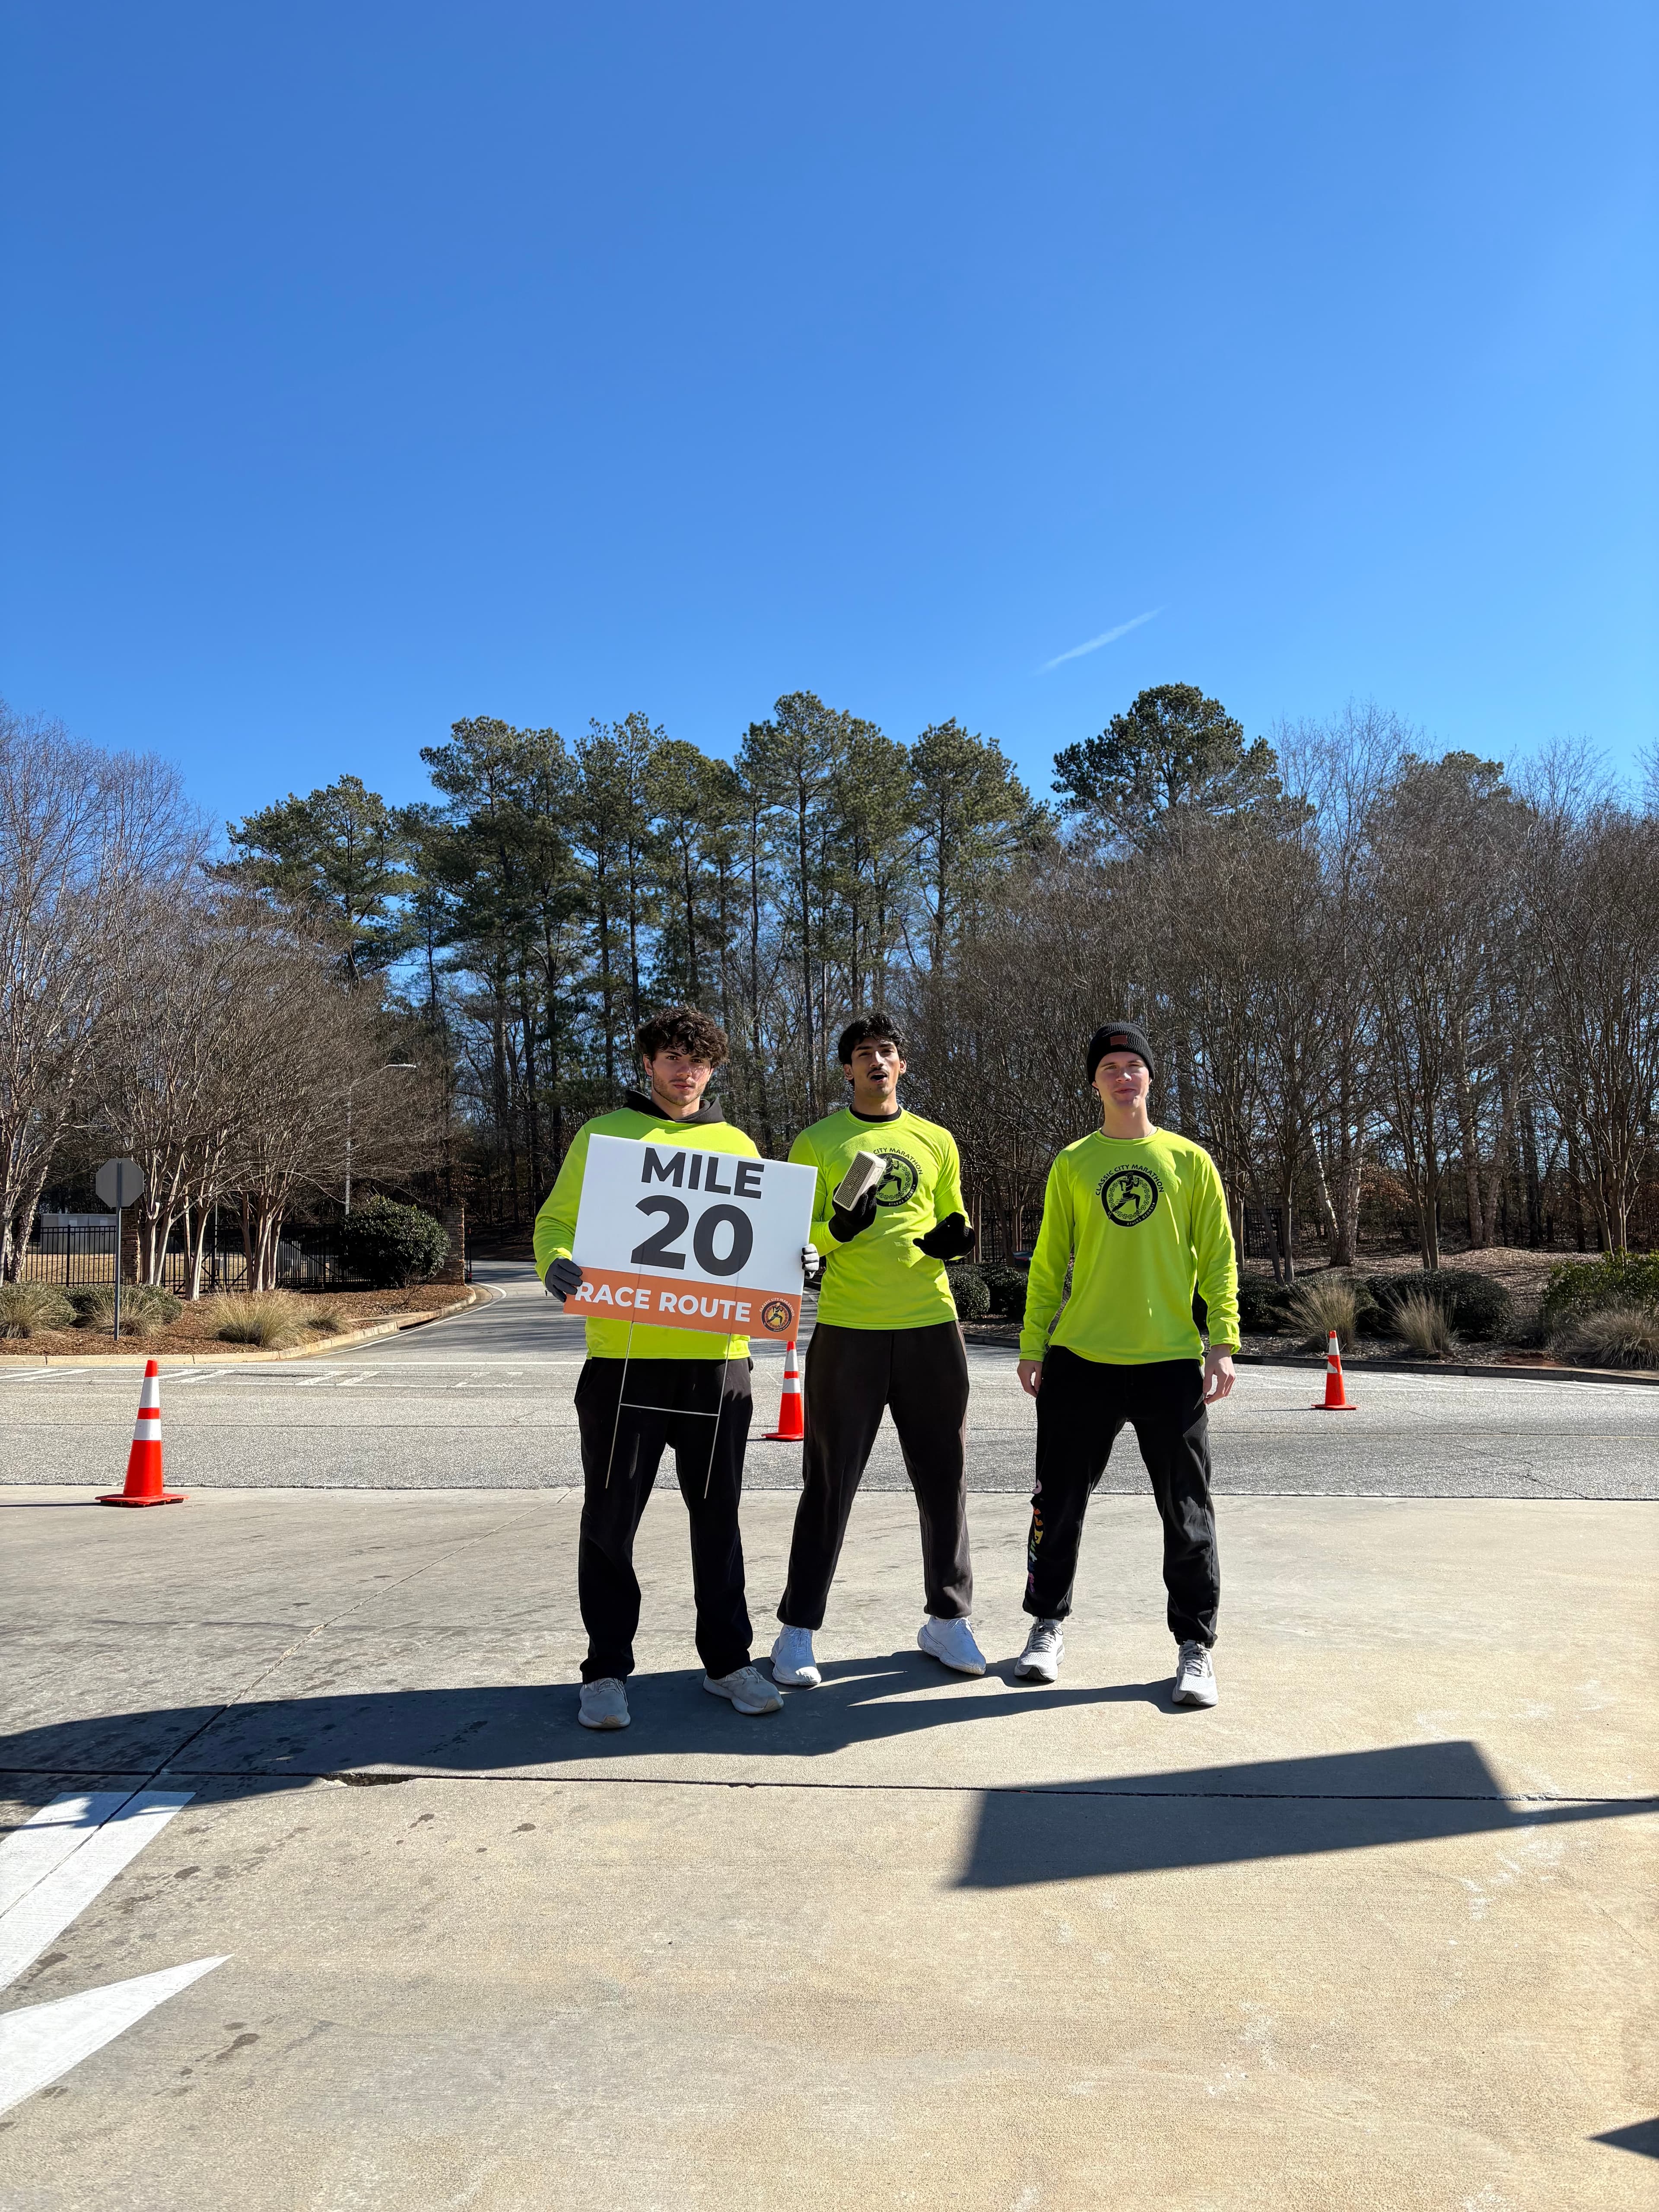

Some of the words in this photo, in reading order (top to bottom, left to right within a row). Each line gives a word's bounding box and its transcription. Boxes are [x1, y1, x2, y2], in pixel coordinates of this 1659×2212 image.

[641, 1147, 765, 1199] MILE
[889, 1147, 923, 1175] MARATHON
[1096, 1170, 1114, 1196] CLASSIC
[1131, 1164, 1164, 1193] MARATHON
[630, 1195, 753, 1277] 20
[575, 1281, 652, 1309] RACE
[659, 1292, 752, 1322] ROUTE
